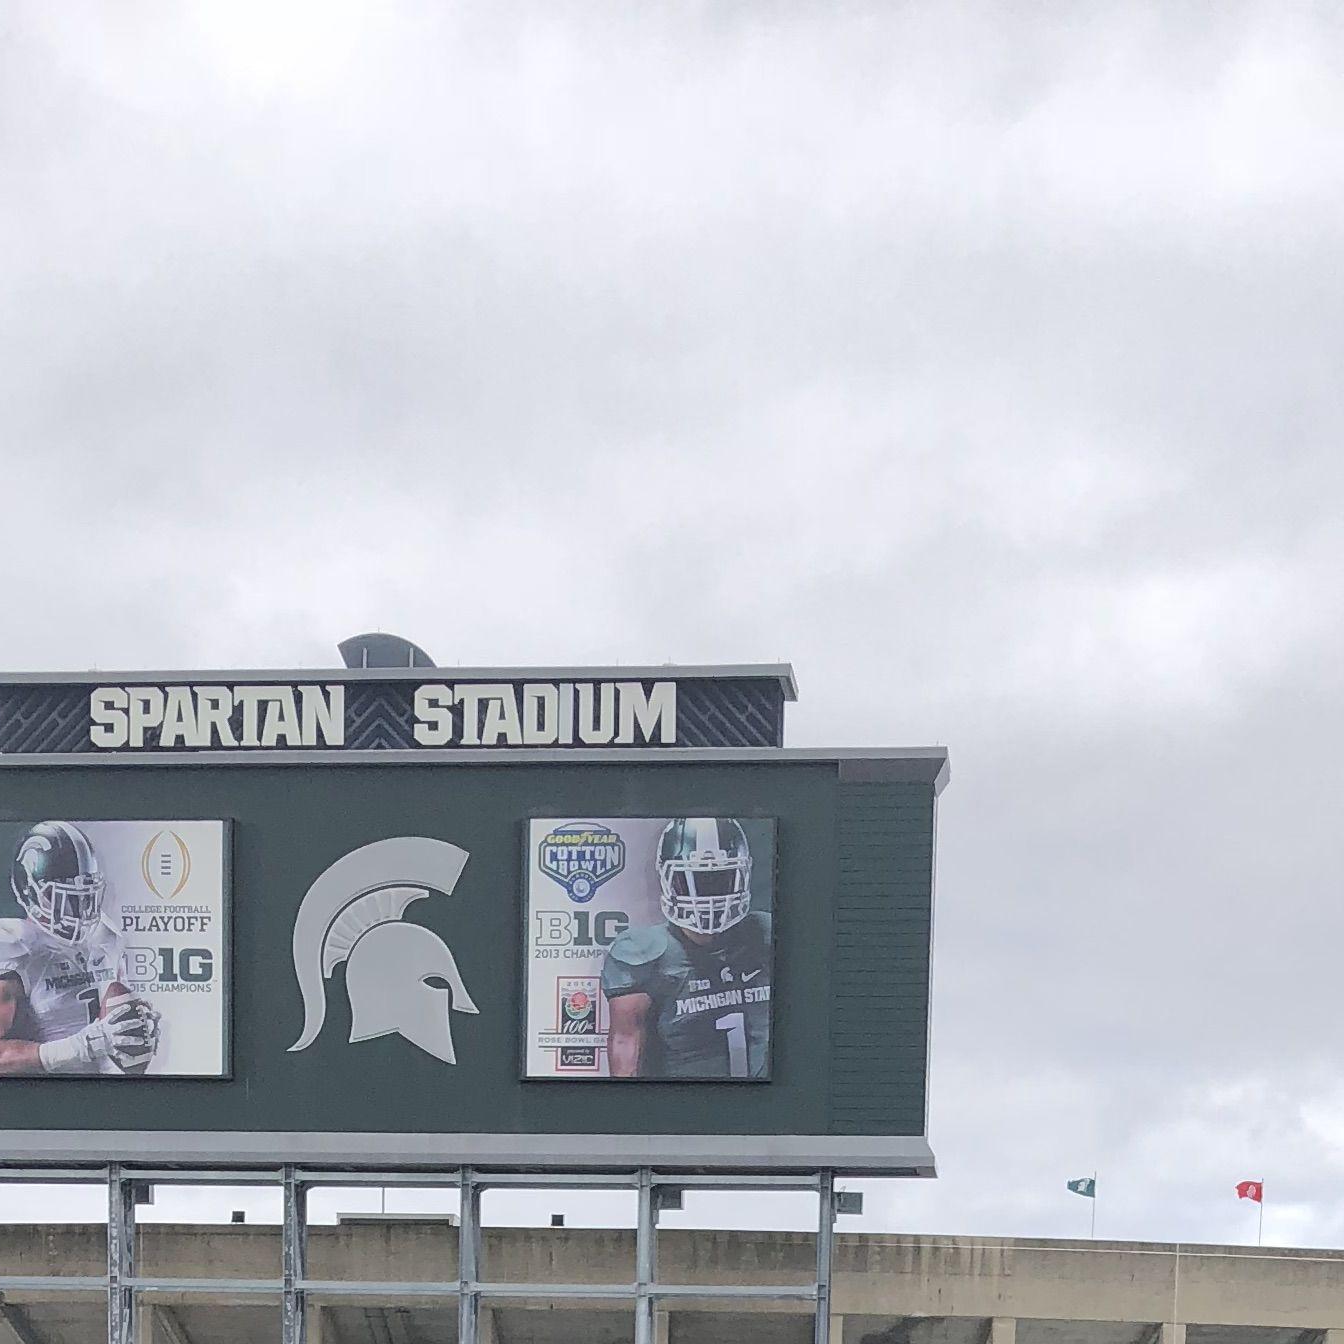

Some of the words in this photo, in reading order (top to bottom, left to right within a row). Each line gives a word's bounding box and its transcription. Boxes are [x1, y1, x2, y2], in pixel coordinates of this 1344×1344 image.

[89, 683, 346, 748] SPARTAN
[413, 682, 677, 746] STADIUM
[545, 846, 619, 871] COTTON
[121, 905, 162, 914] COLLEGE
[163, 905, 212, 914] FOOTBALL
[121, 915, 212, 932] PLAYOFF
[535, 949, 560, 959] 2013
[563, 949, 608, 959] CHAMP
[149, 983, 212, 993] CHAMPIONS
[676, 990, 743, 1016] MICHIGAN
[716, 1012, 748, 1078] 1
